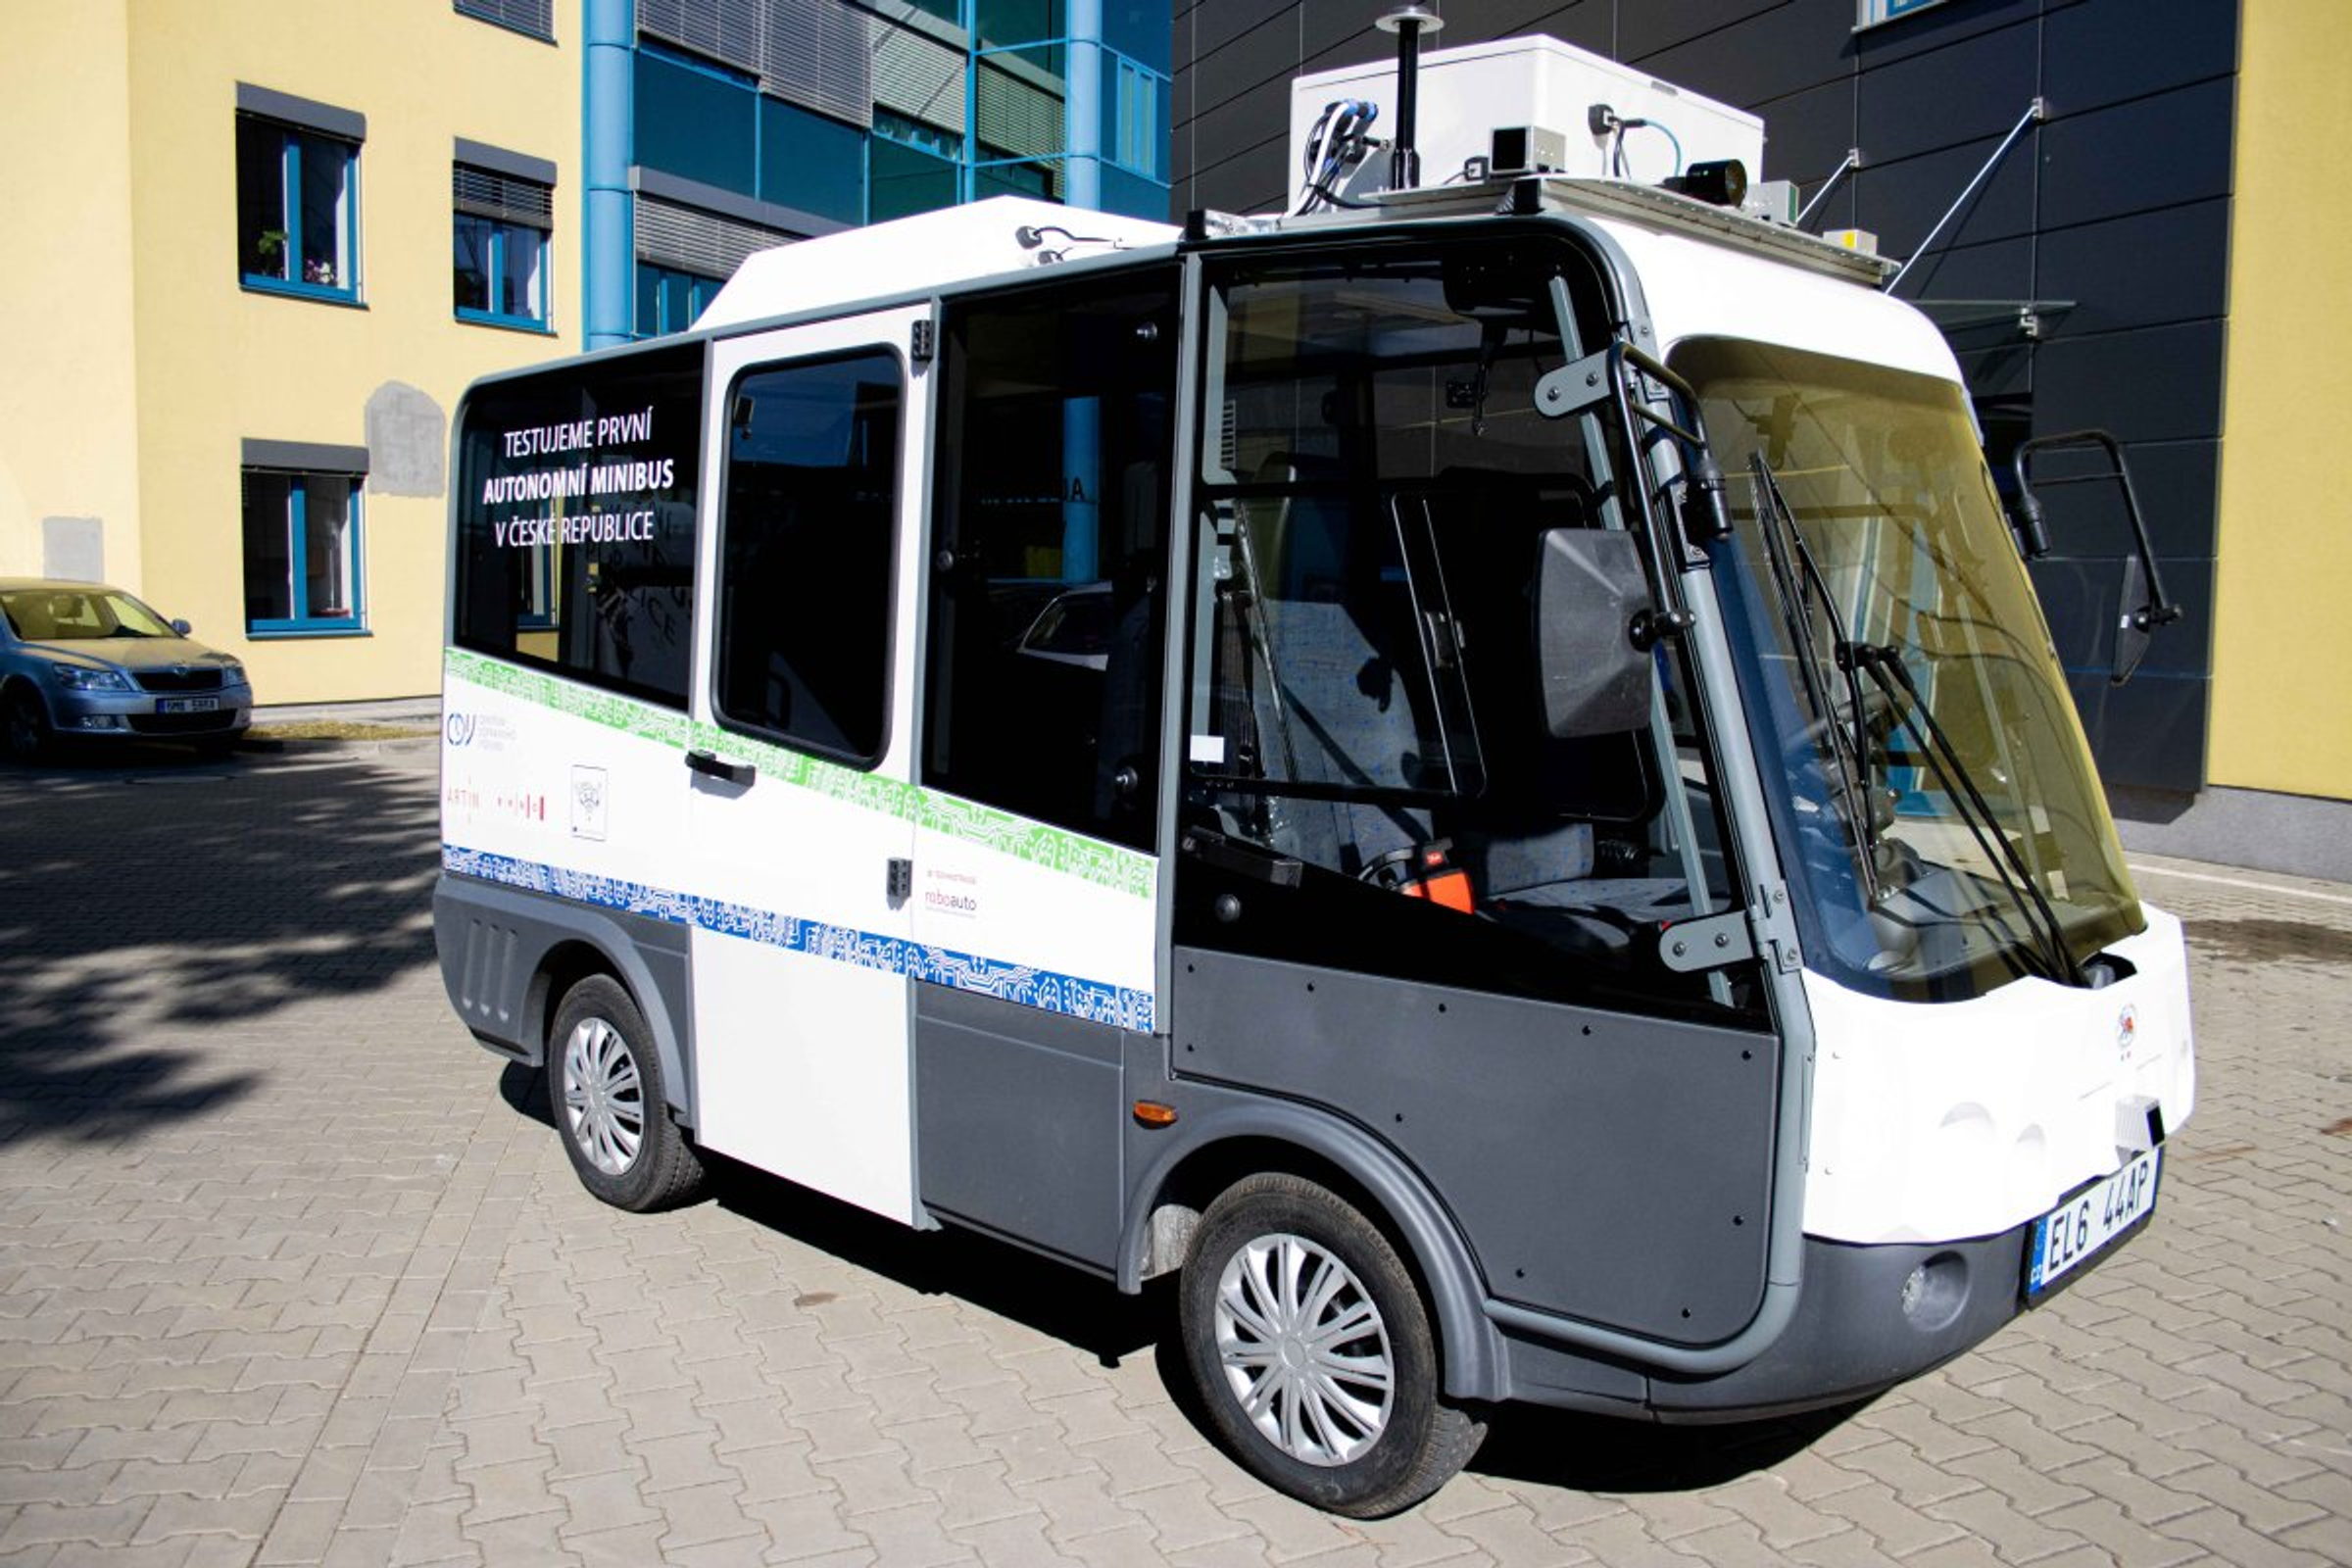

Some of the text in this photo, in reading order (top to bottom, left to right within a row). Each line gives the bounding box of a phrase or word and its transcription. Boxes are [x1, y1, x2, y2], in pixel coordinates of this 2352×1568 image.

[504, 405, 654, 458] TESTUJEME PRVNÍ
[483, 459, 674, 505] AUTONOMNÍ MINIBUS
[495, 512, 654, 548] V ČESKÉ REPUBLICE
[924, 888, 977, 911] roboauto
[2048, 1159, 2149, 1273] EL6 44AP
